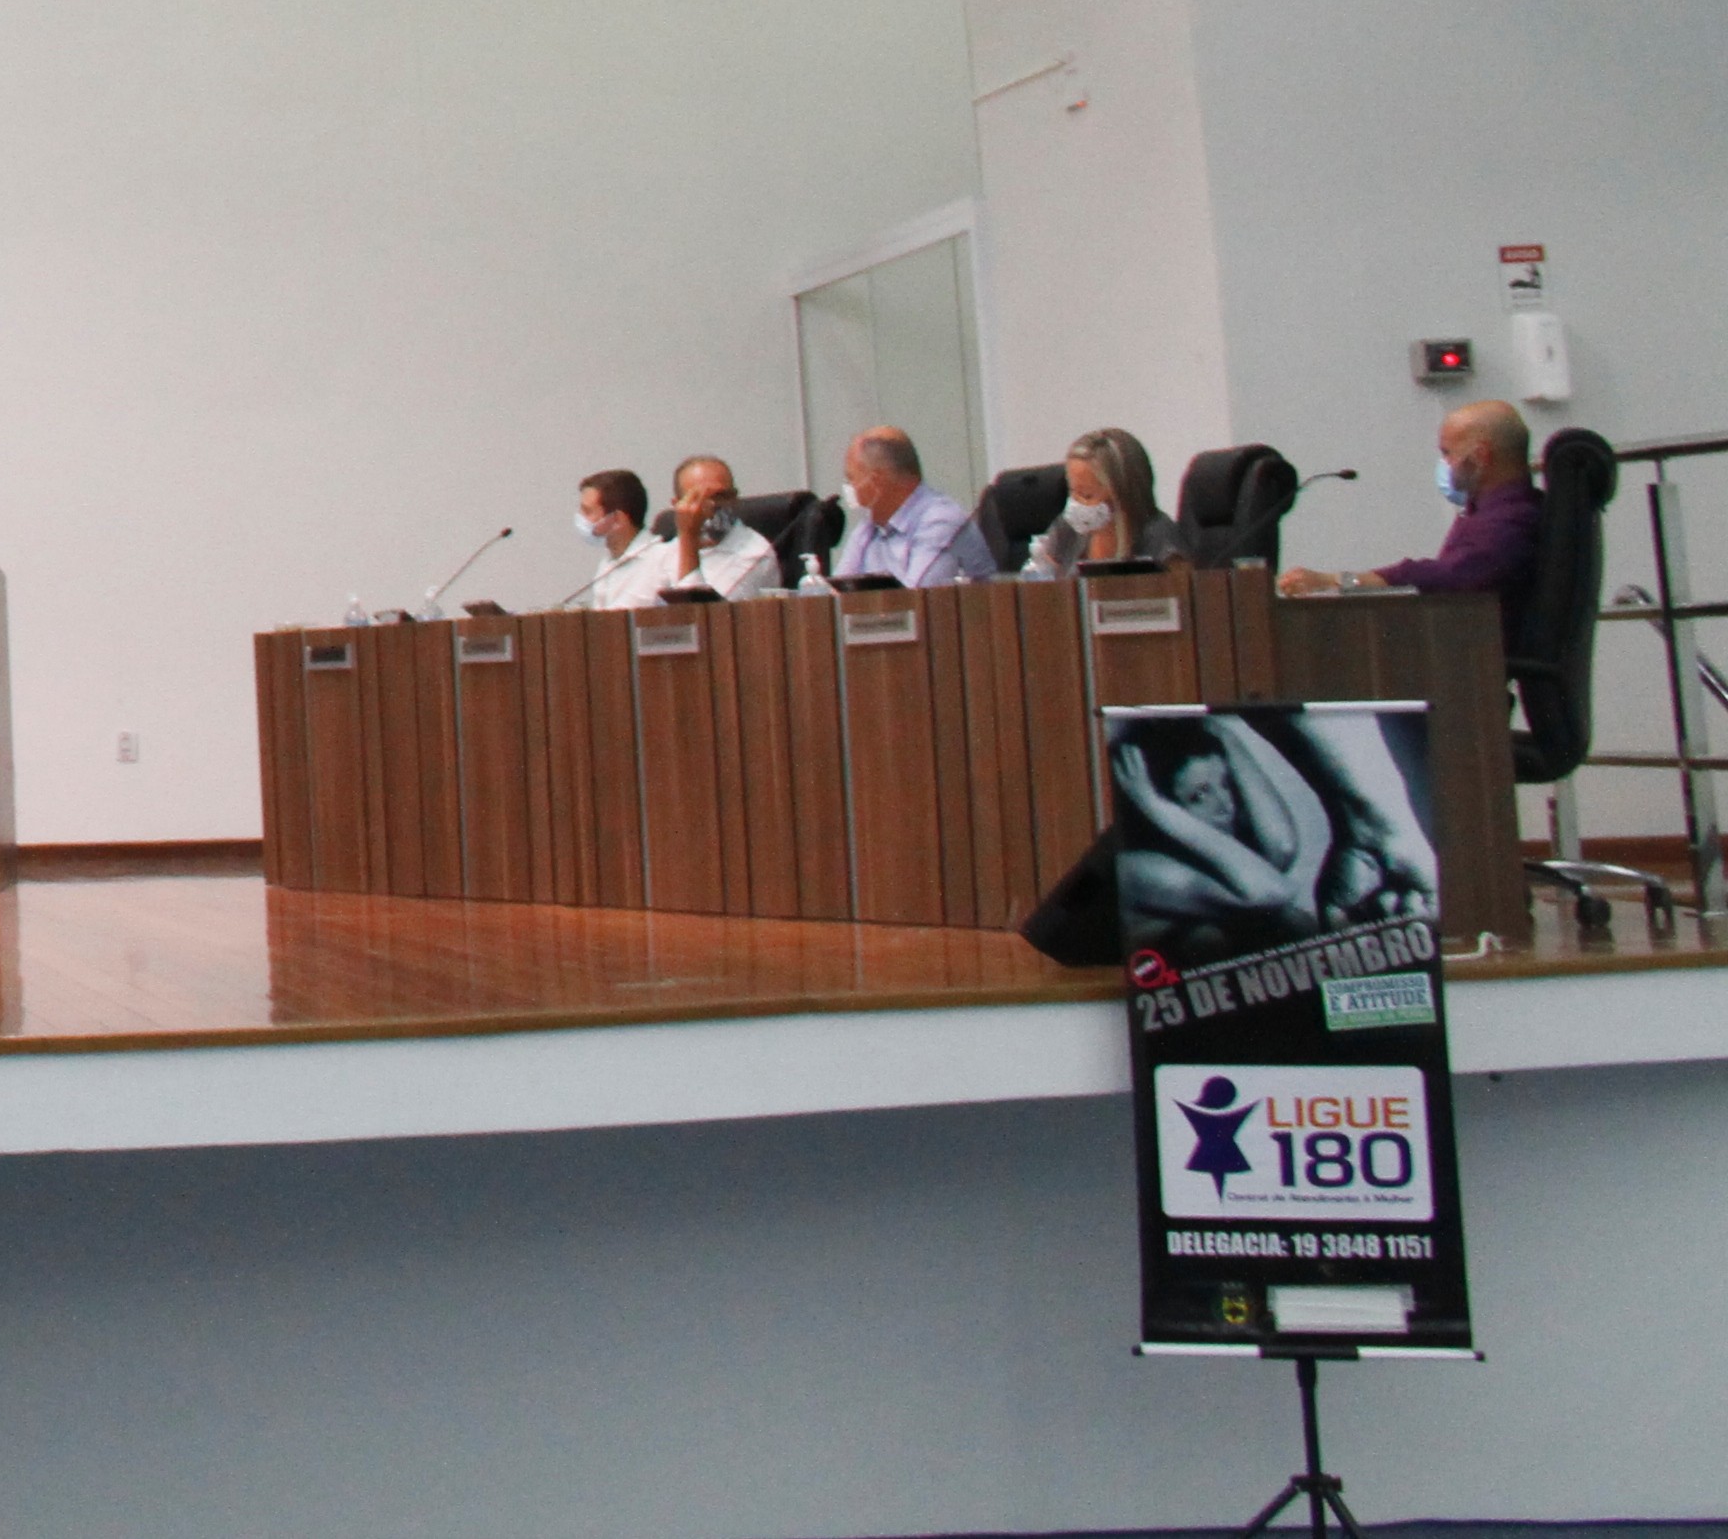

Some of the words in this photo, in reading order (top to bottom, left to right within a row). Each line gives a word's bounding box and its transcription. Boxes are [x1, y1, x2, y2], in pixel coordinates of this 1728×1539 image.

[1136, 987, 1186, 1032] 25
[1186, 972, 1237, 1018] DE
[1236, 922, 1435, 1005] NOVEMBRO
[1266, 1097, 1410, 1129] LIGUE
[1270, 1132, 1412, 1187] 180
[1167, 1231, 1288, 1256] DELEGACIA:
[1291, 1234, 1318, 1257] 19
[1323, 1235, 1380, 1258] 3848
[1385, 1236, 1433, 1259] 1151
